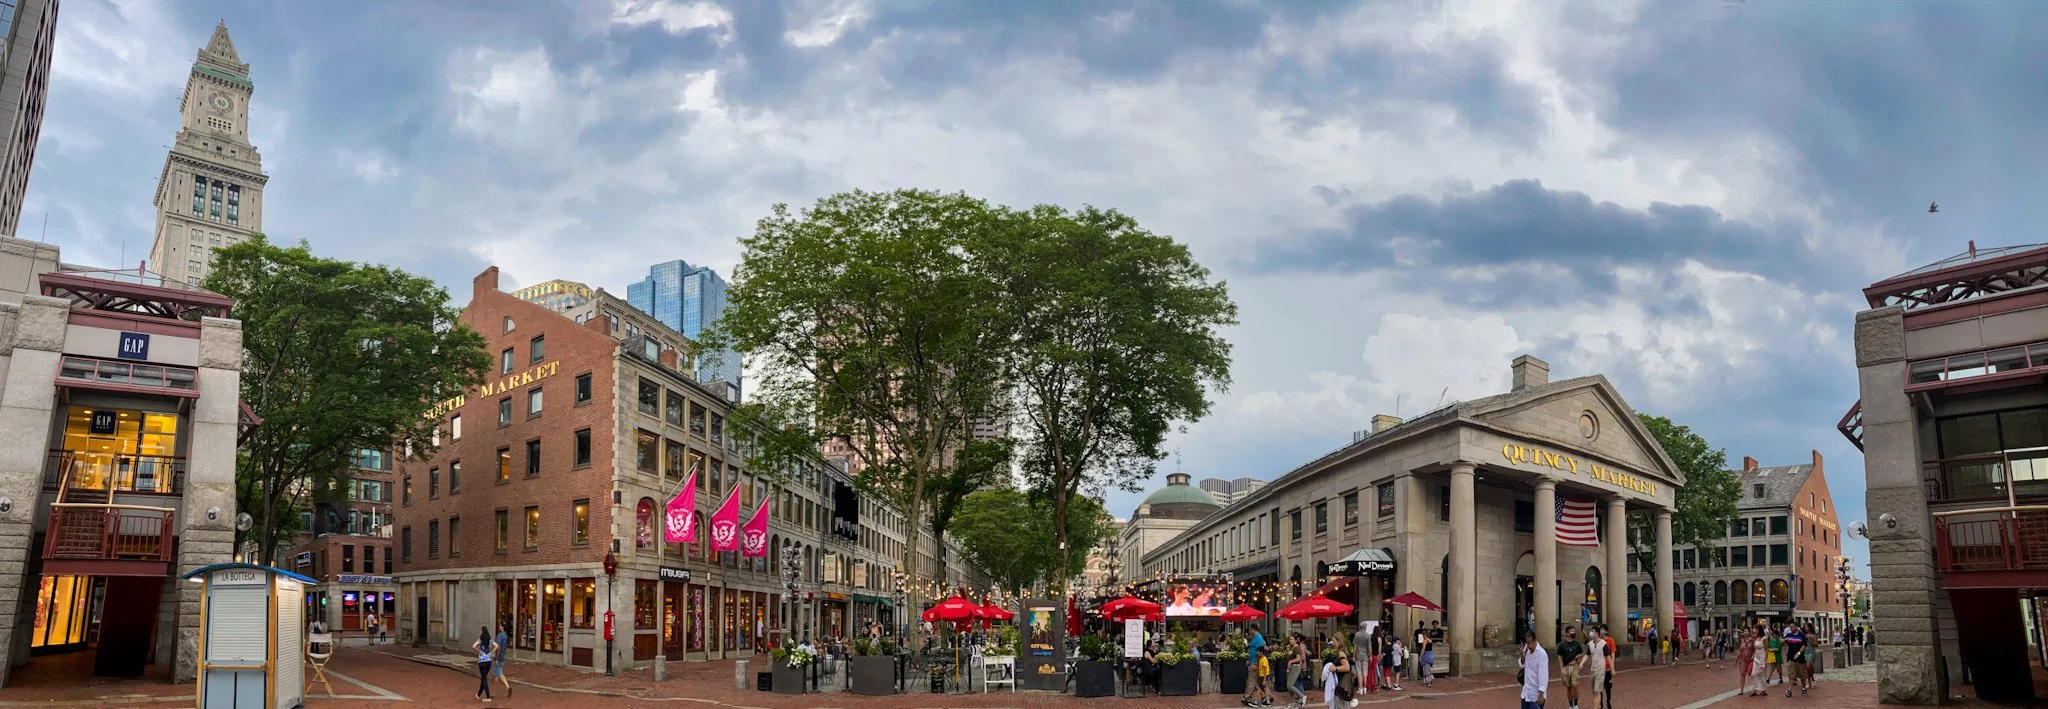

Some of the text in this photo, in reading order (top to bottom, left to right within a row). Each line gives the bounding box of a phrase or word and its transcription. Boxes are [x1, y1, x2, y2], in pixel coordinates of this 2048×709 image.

[124, 338, 144, 353] GAP
[423, 360, 560, 419] SOUTH MARKET
[96, 415, 111, 426] GAP
[1503, 444, 1657, 496] QUINCY MARKET
[1800, 507, 1837, 530] NORTH MARKET
[1358, 562, 1371, 571] Ned
[231, 572, 256, 581] BOTTEGA
